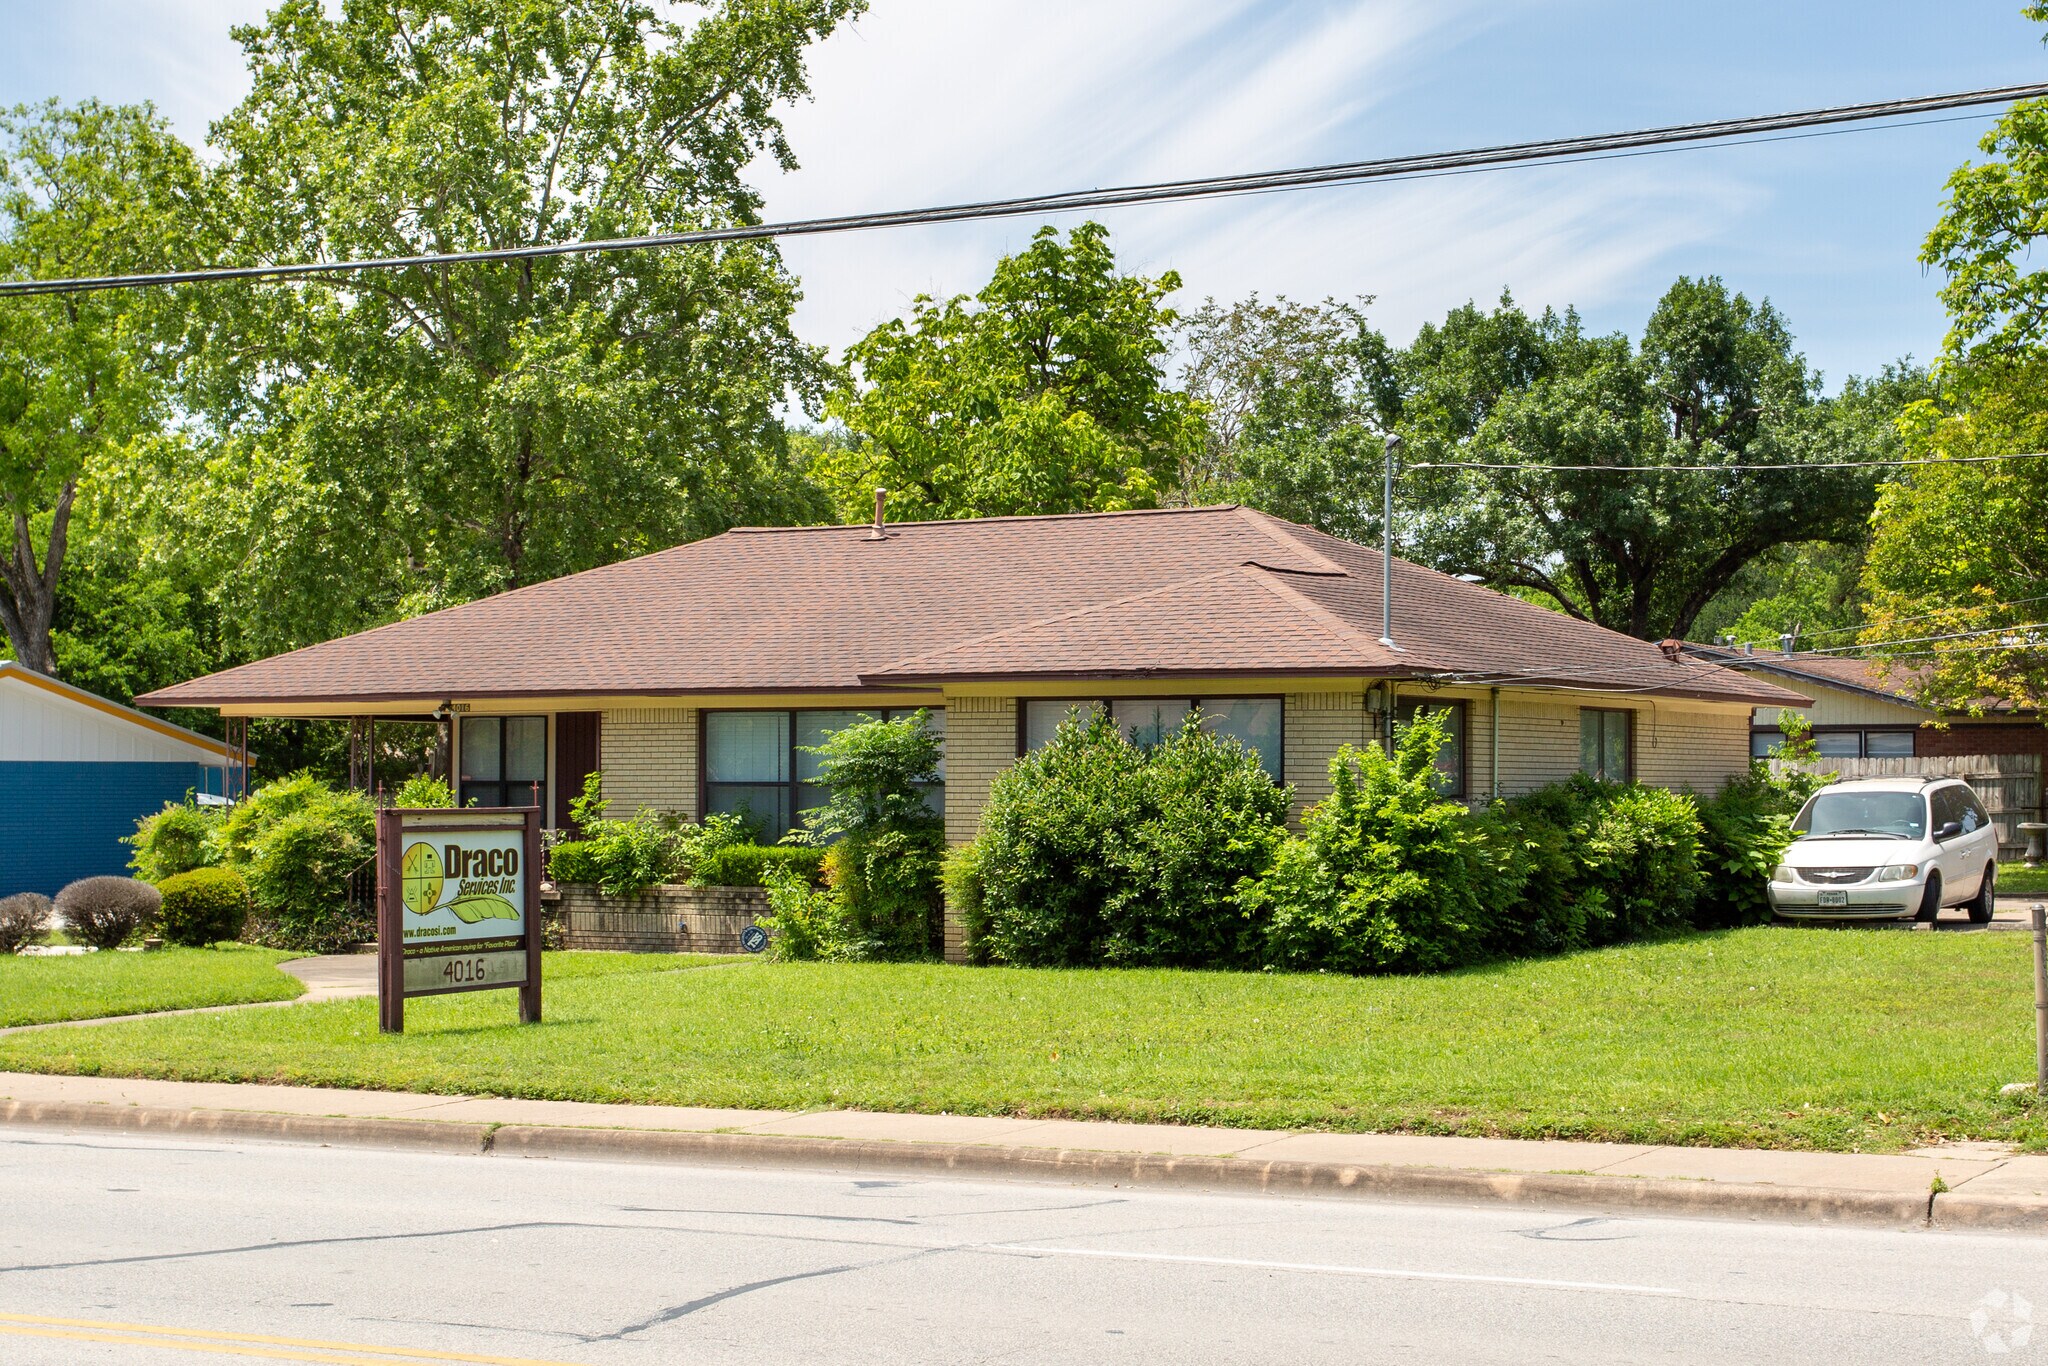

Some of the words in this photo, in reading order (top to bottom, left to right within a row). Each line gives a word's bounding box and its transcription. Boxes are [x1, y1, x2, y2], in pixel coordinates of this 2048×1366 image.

[452, 704, 470, 712] 4016
[444, 844, 519, 879] Draco
[457, 878, 498, 896] Services
[498, 877, 516, 894] Inc.
[402, 925, 457, 938] ww.dracosi.com
[424, 946, 440, 954] Native
[443, 958, 485, 983] 4016
